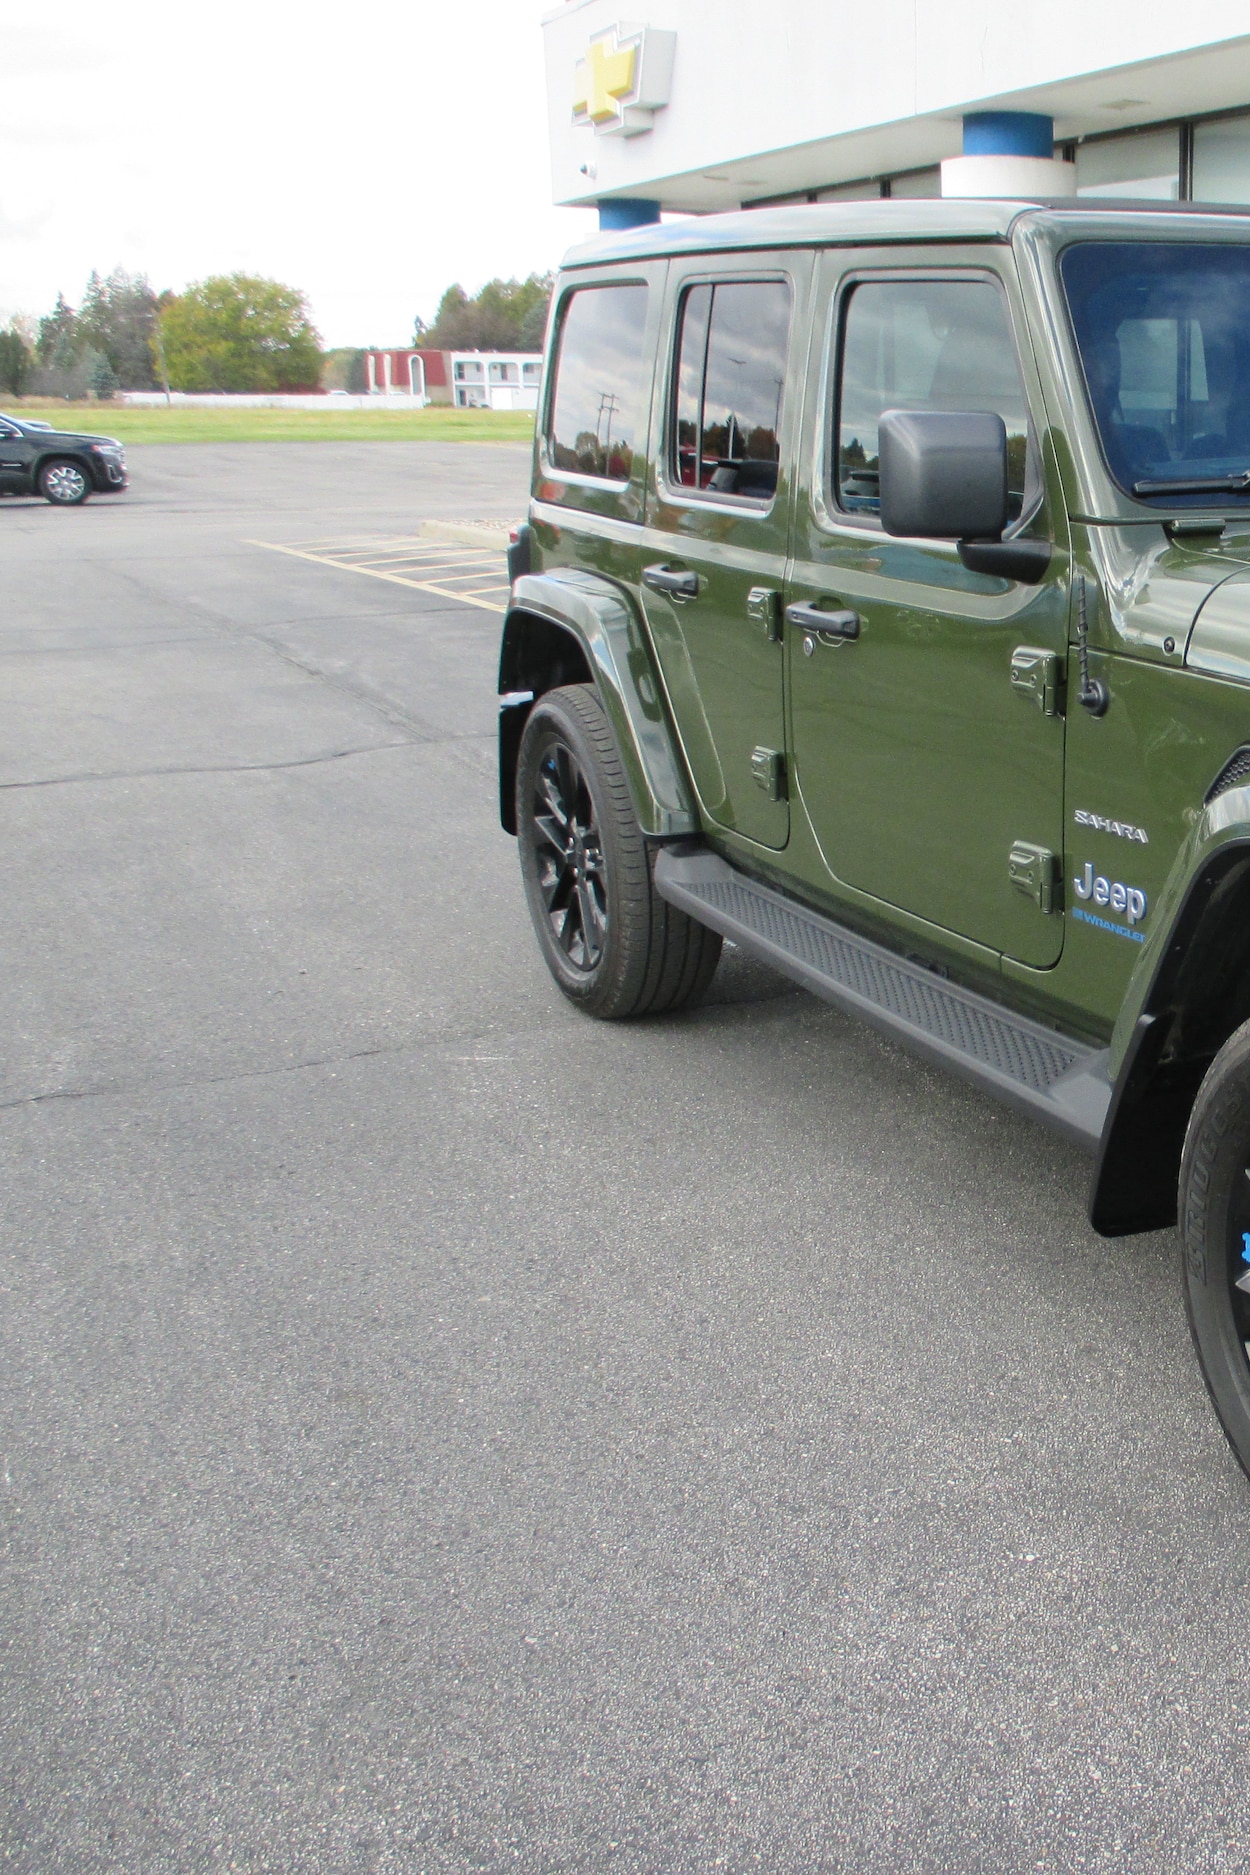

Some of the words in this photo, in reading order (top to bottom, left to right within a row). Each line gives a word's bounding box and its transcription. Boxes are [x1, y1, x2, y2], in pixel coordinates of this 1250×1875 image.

[1074, 809, 1149, 844] SAHARA
[1073, 862, 1147, 925] Jeep
[1082, 913, 1146, 943] WRANGLER
